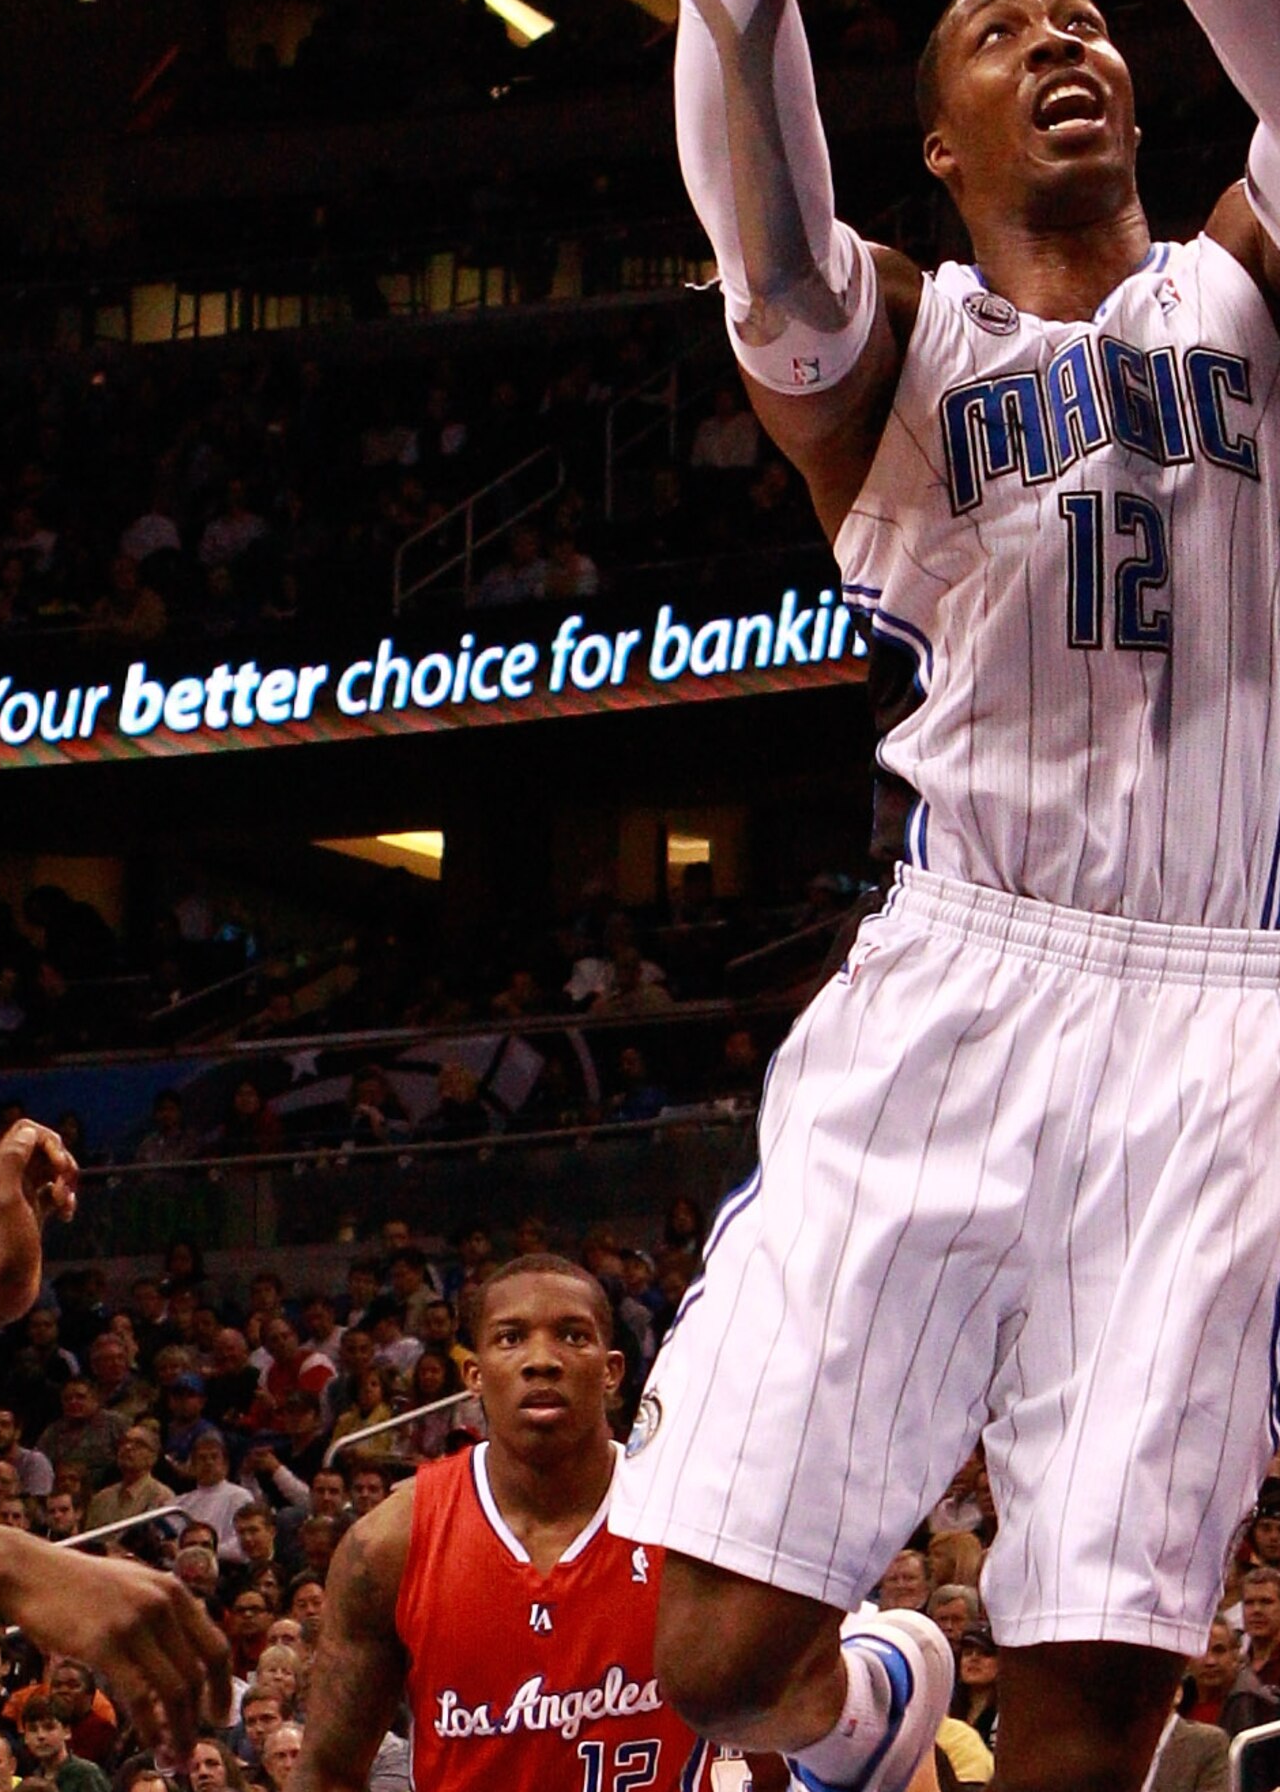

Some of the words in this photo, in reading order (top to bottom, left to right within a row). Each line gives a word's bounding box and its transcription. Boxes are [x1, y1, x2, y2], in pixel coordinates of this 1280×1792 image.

[938, 333, 1263, 518] MAGIC
[1059, 490, 1172, 654] 12
[118, 661, 328, 734] better
[336, 633, 537, 715] choice
[549, 615, 637, 690] for
[434, 1689, 495, 1738] Los
[500, 1666, 663, 1740] Angeles
